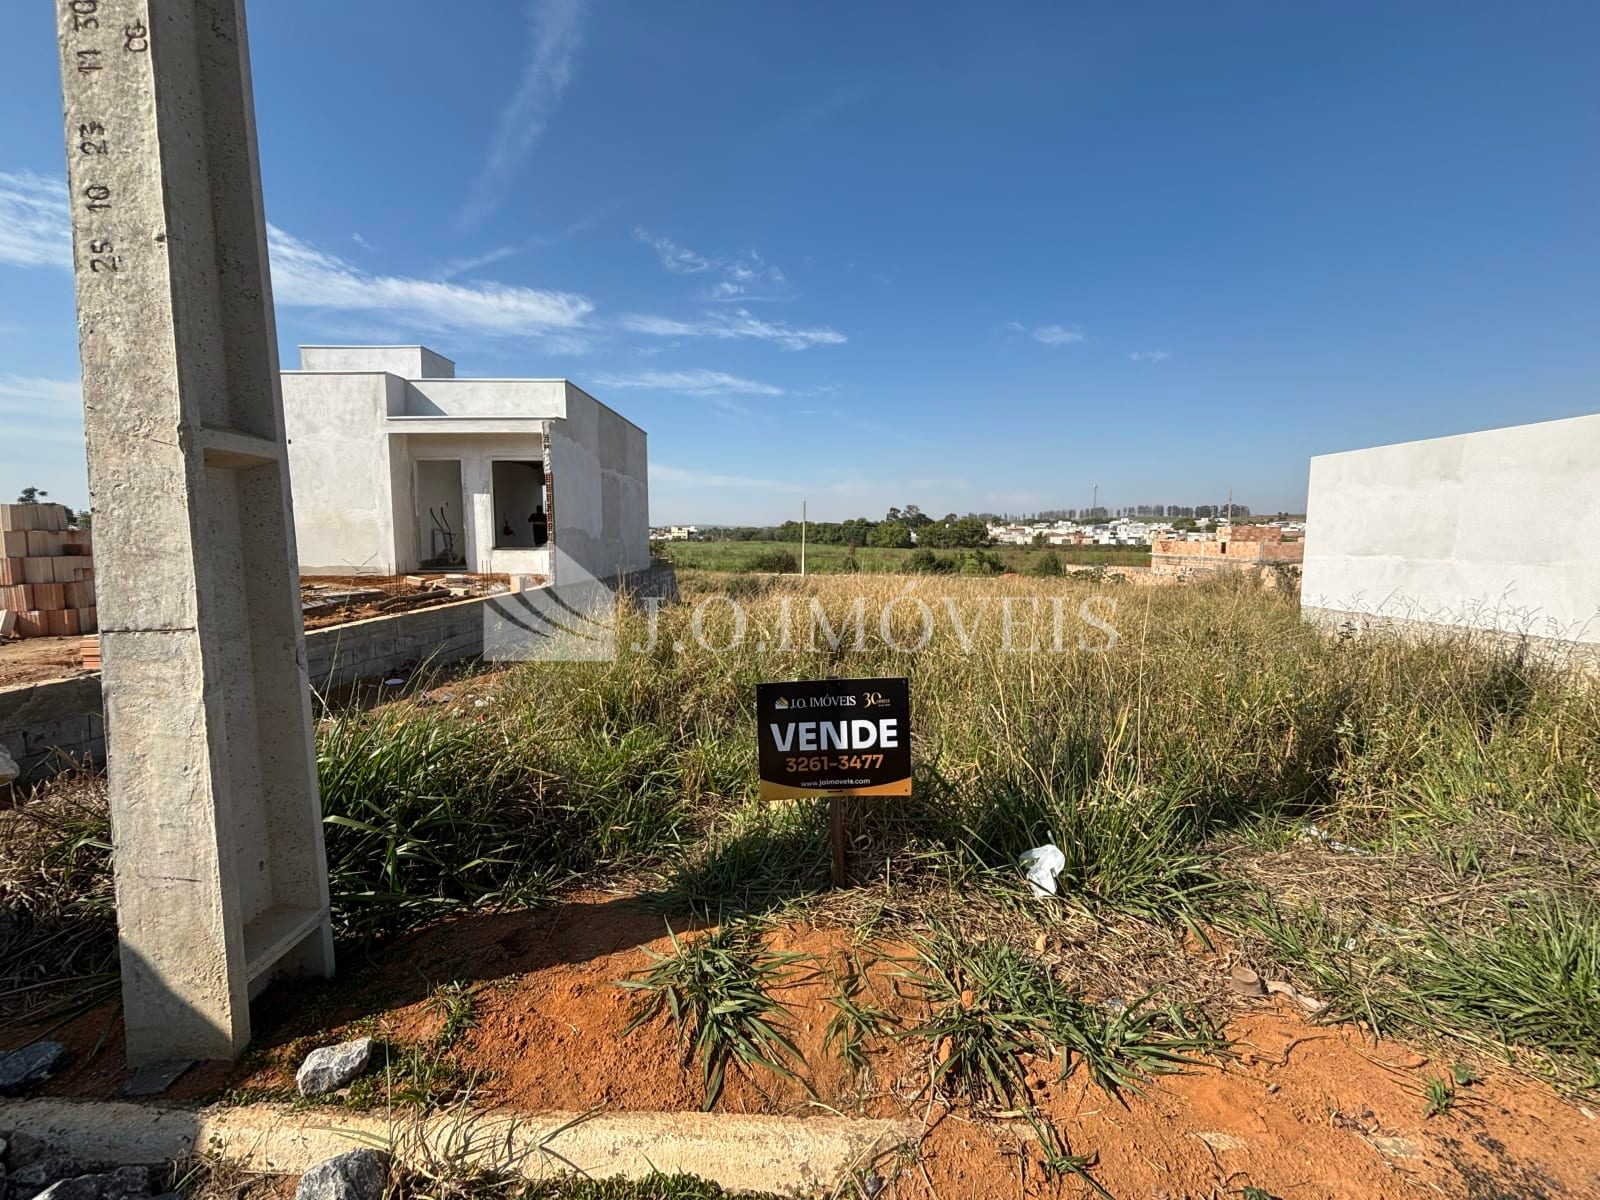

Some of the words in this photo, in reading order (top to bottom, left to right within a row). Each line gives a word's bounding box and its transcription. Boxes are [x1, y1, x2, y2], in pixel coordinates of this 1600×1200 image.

[77, 48, 103, 75] 11
[79, 121, 109, 156] 23
[86, 185, 112, 213] 10
[90, 240, 119, 273] 25
[810, 693, 857, 708] IMÓVEIS
[769, 718, 899, 752] VENDE
[786, 753, 884, 773] 3261-3477
[801, 777, 871, 788] www.joimoveis.com
